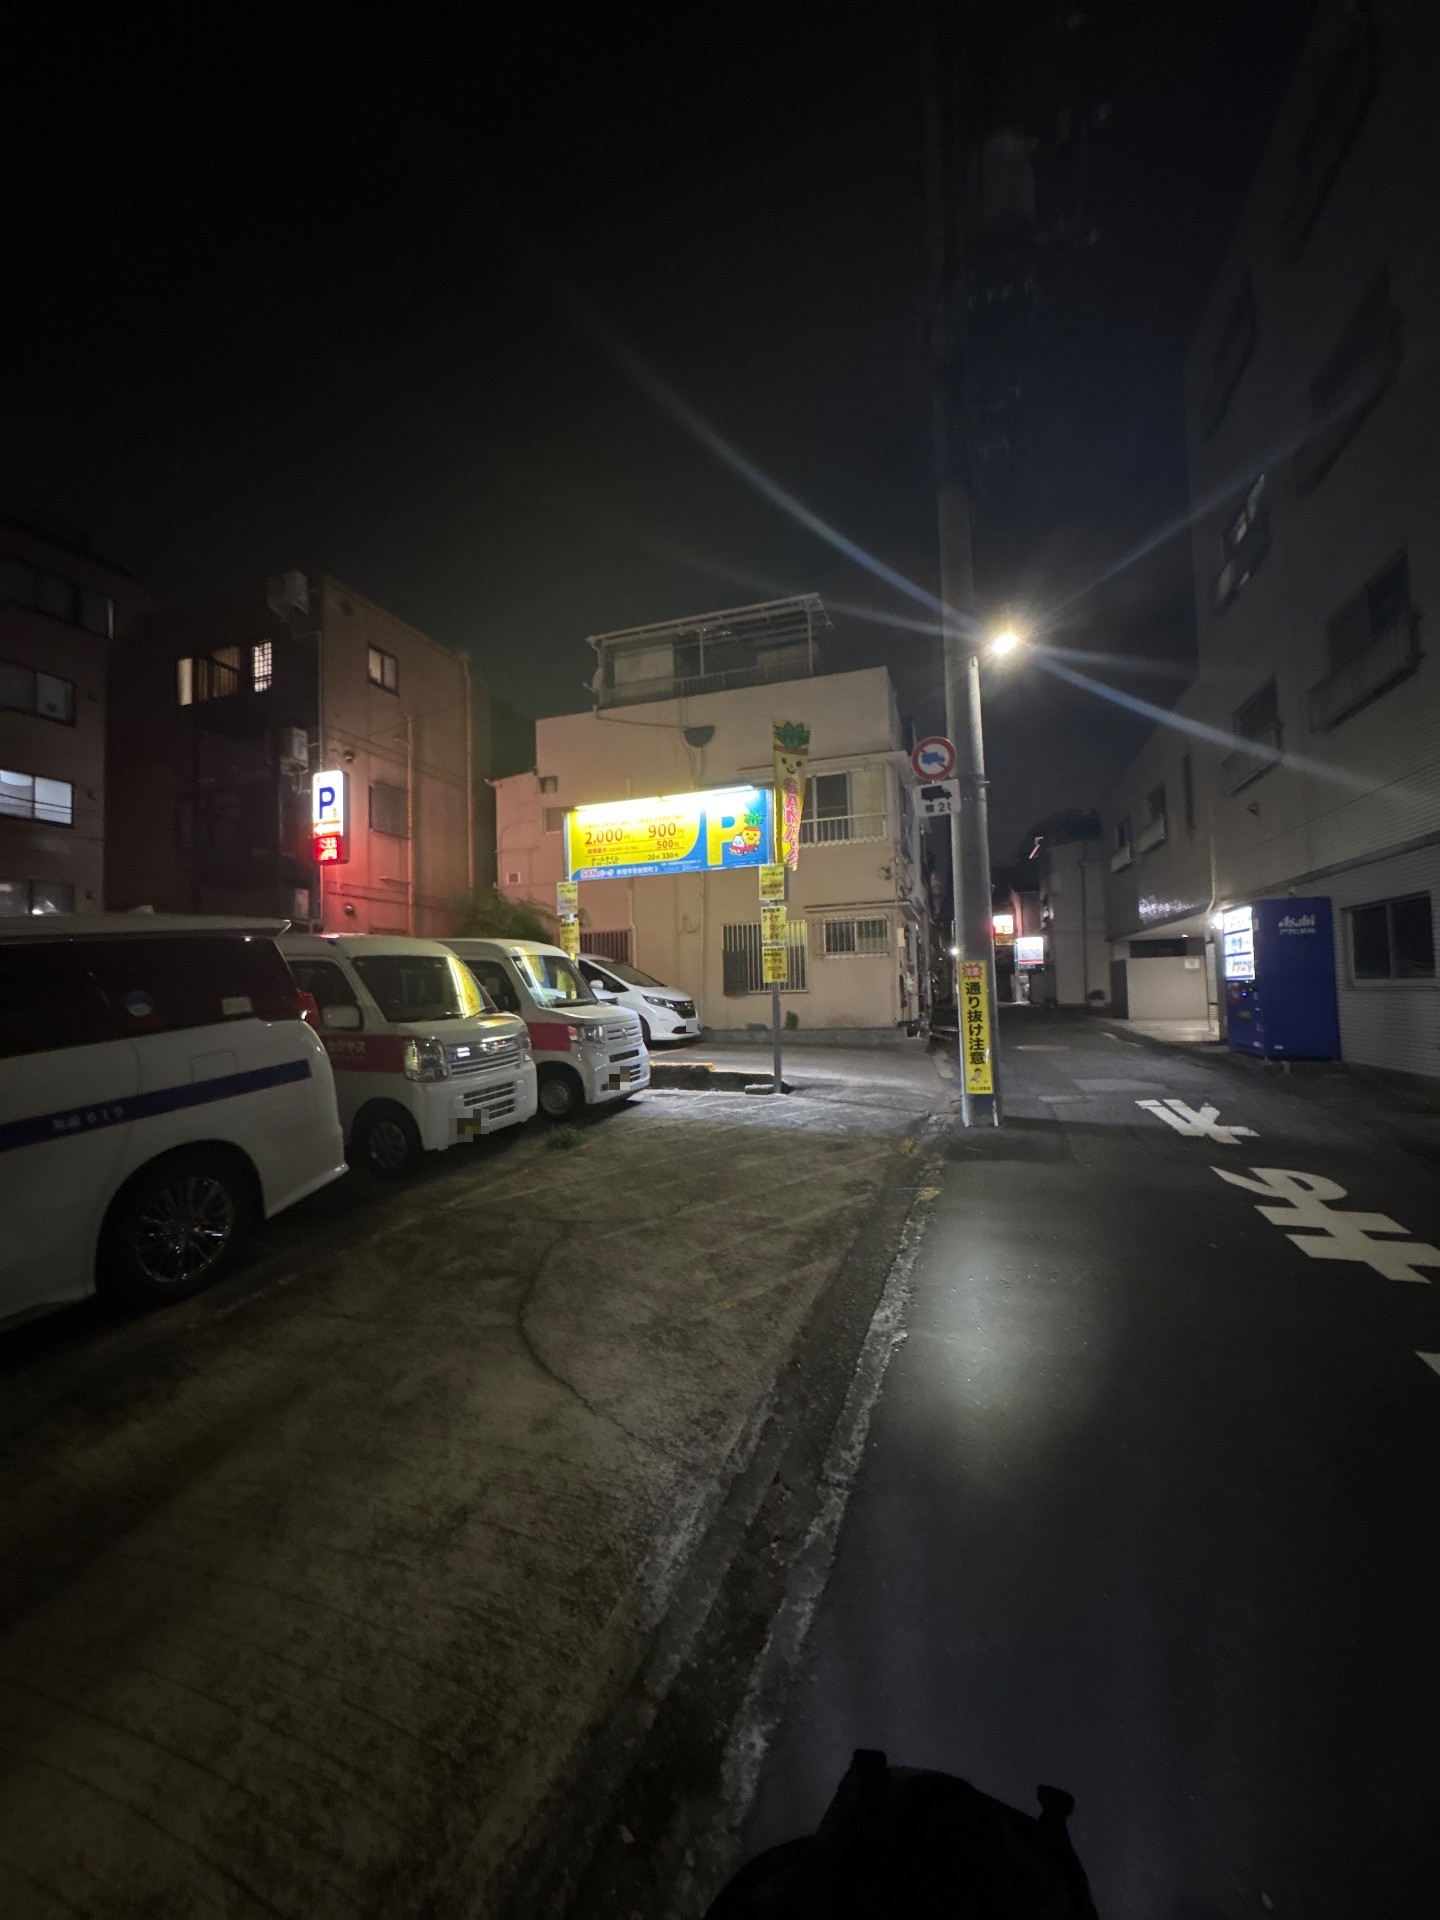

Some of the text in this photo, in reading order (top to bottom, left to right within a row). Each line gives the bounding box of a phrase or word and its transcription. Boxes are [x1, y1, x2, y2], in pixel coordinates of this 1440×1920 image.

[319, 786, 335, 819] P
[706, 797, 749, 866] P
[1278, 913, 1317, 928] Asahi
[964, 981, 987, 1065] 通り抜け注意
